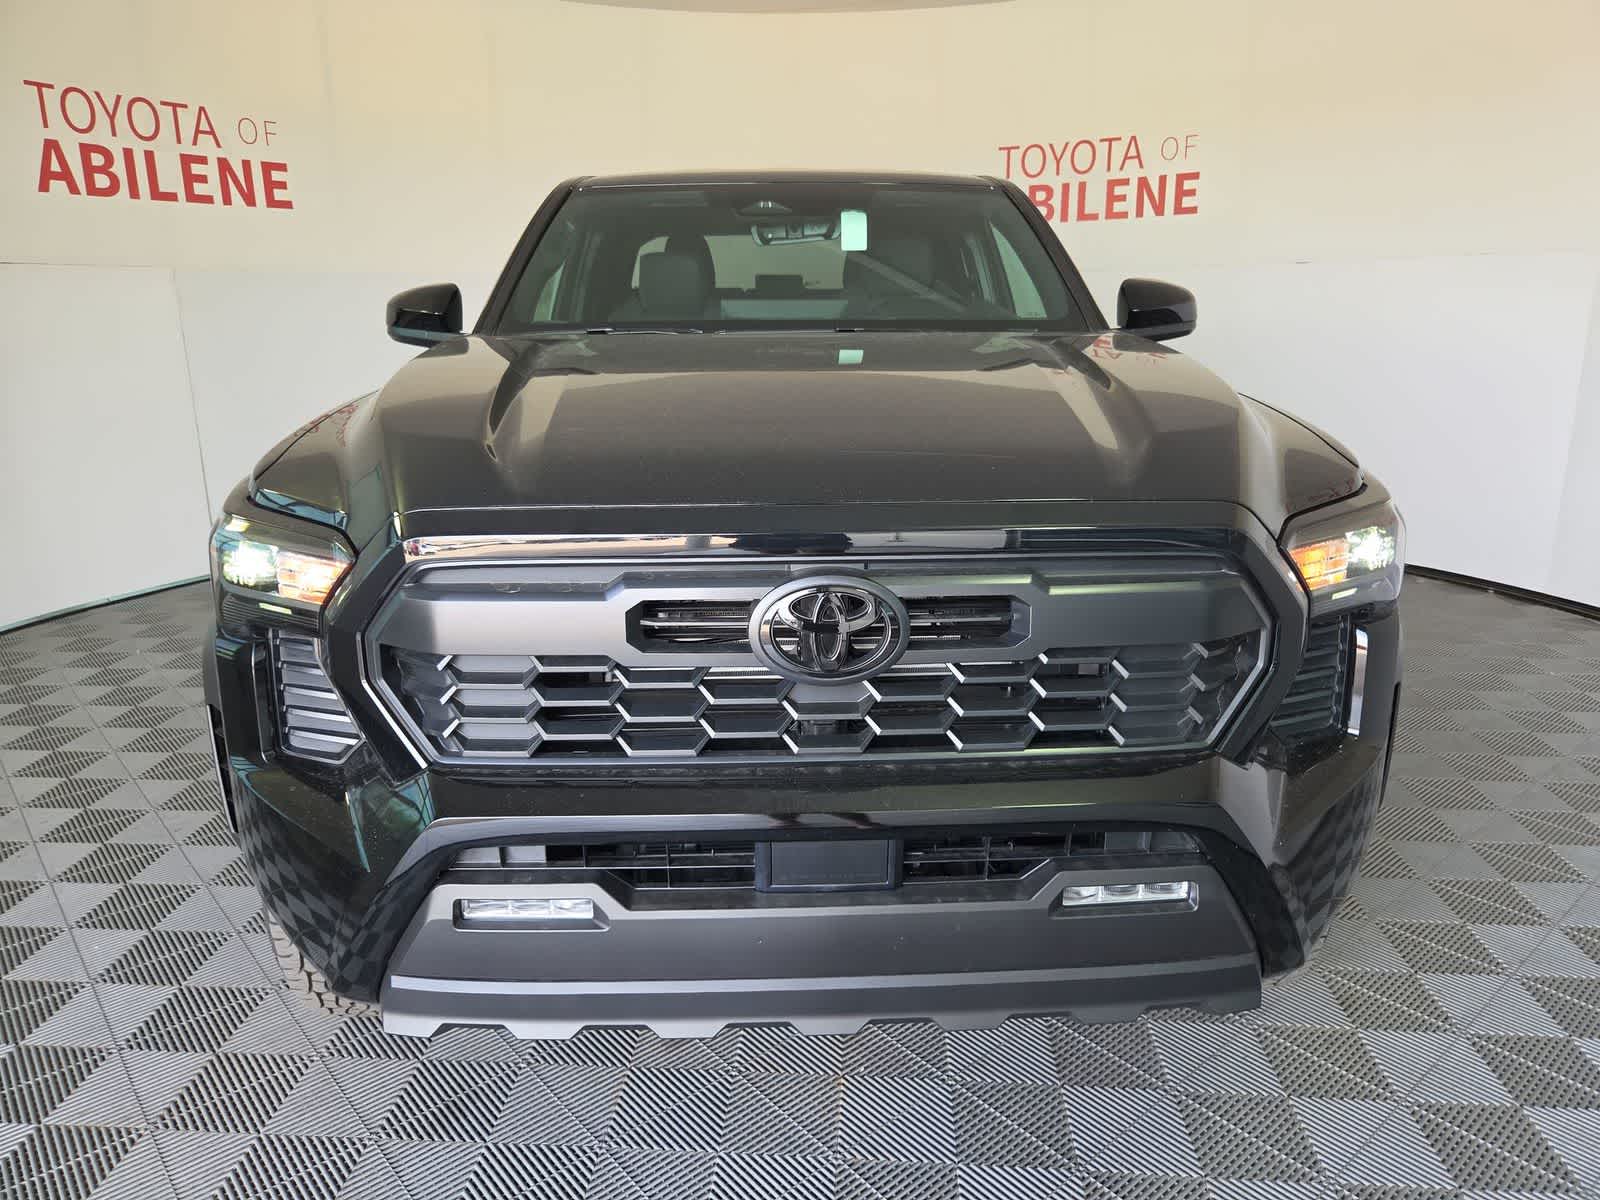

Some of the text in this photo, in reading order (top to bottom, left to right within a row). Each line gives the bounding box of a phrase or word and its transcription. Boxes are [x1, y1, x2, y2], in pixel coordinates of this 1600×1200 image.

[23, 79, 278, 148] TOYOTA OF
[38, 138, 294, 210] ABILENE
[998, 134, 1201, 180] TOYOTA OF
[1027, 170, 1201, 223] BILENE
